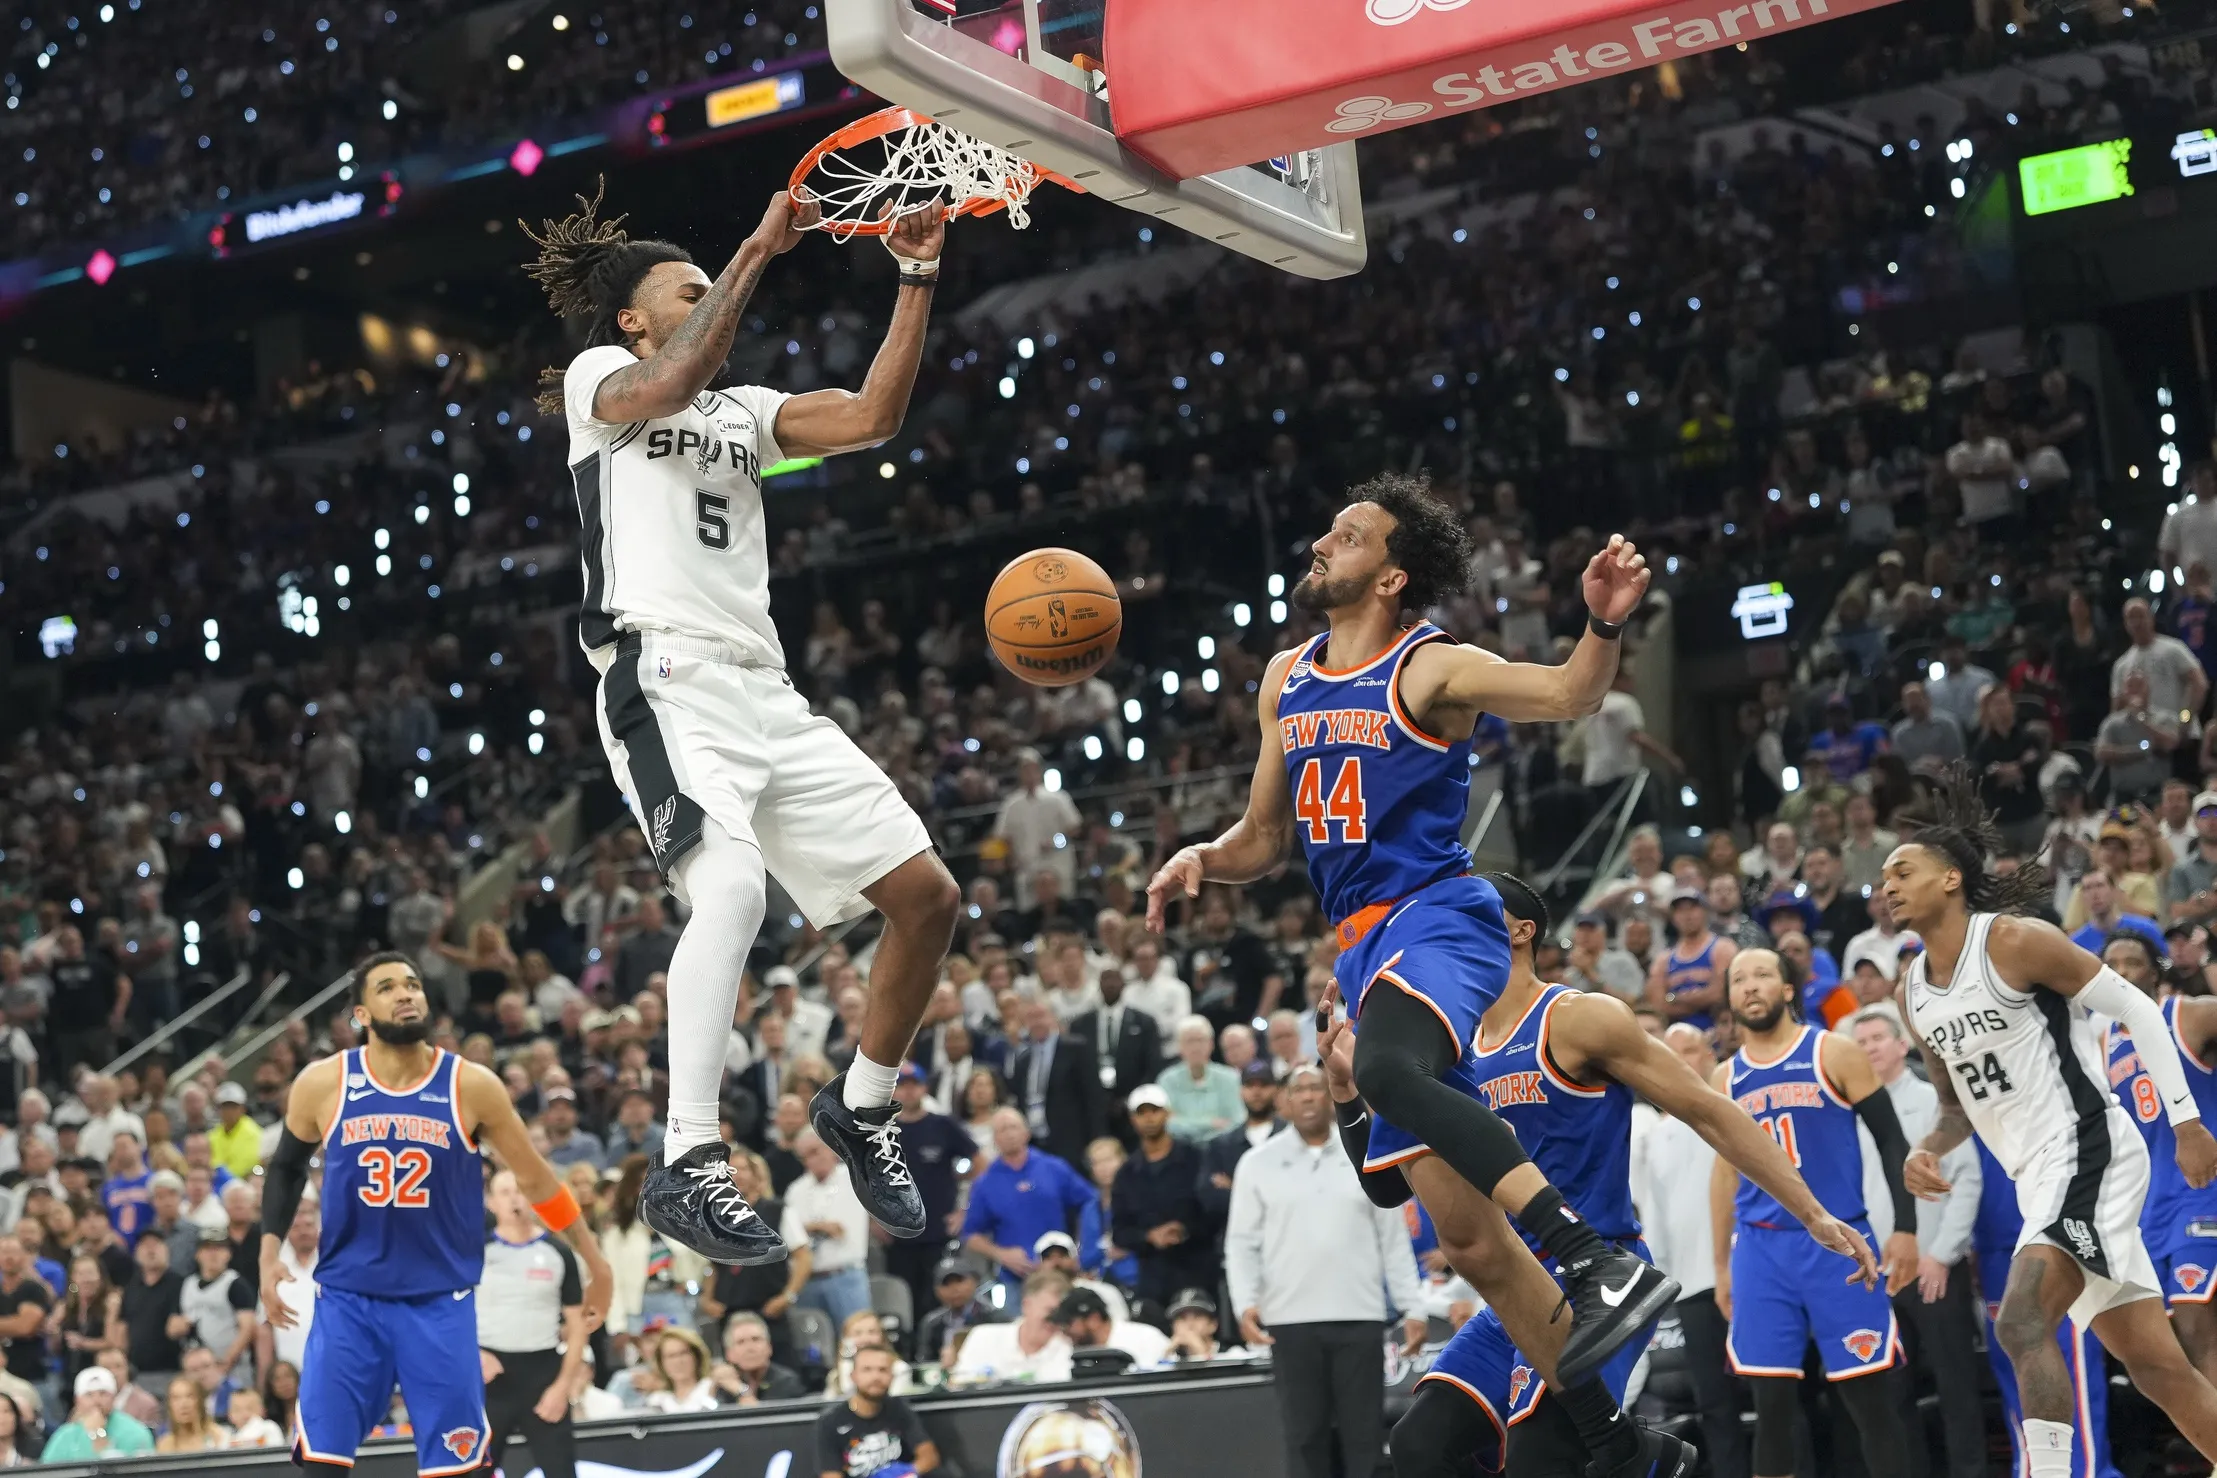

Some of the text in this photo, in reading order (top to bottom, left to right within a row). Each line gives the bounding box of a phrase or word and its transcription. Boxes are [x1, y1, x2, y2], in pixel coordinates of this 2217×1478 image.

[646, 428, 759, 490] SPURS
[695, 487, 732, 553] 5
[1014, 646, 1104, 676] Wilson
[1324, 708, 1391, 751] YORK
[1295, 756, 1367, 844] 44
[1486, 1070, 1549, 1112] YORK
[1767, 1081, 1825, 1110] YORK
[1954, 1050, 2015, 1102] 24
[2131, 1073, 2162, 1123] 8
[341, 1113, 451, 1150] NEW YORK
[357, 1146, 432, 1208] 32
